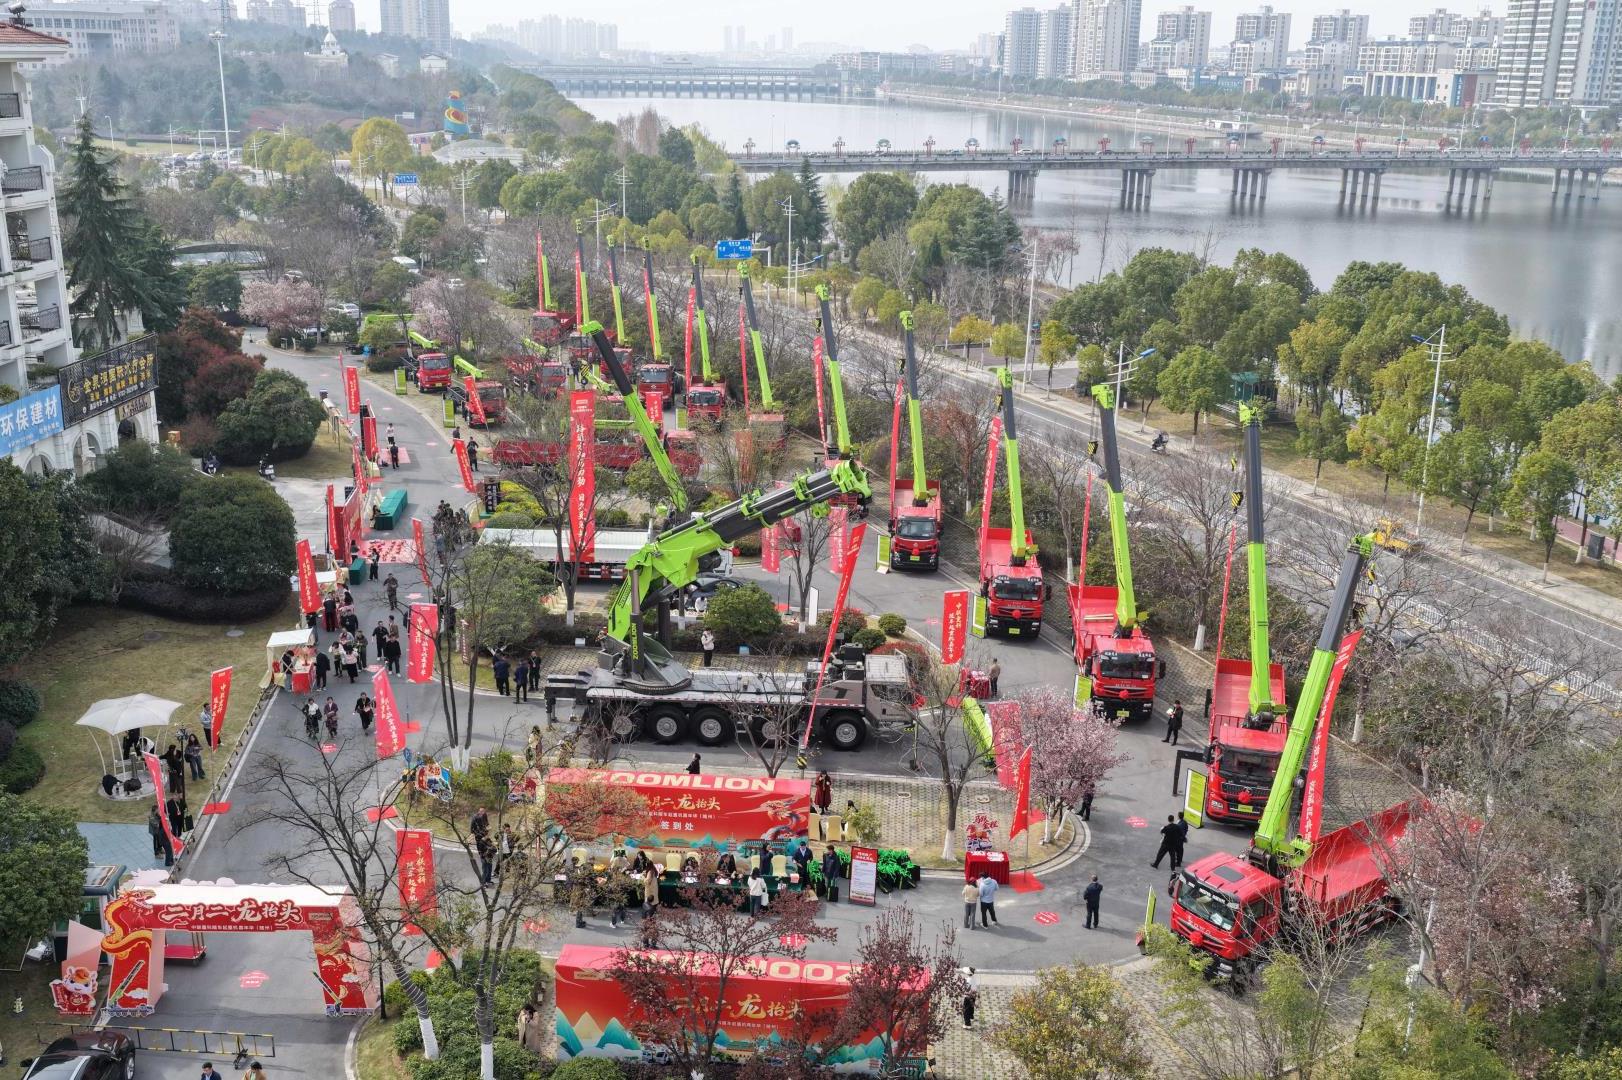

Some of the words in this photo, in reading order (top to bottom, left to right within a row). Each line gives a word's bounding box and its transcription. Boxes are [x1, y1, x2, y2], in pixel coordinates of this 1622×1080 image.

[0, 397, 57, 436] 环保建材
[660, 820, 694, 831] 签到处
[161, 899, 300, 923] 二月二龙抬头
